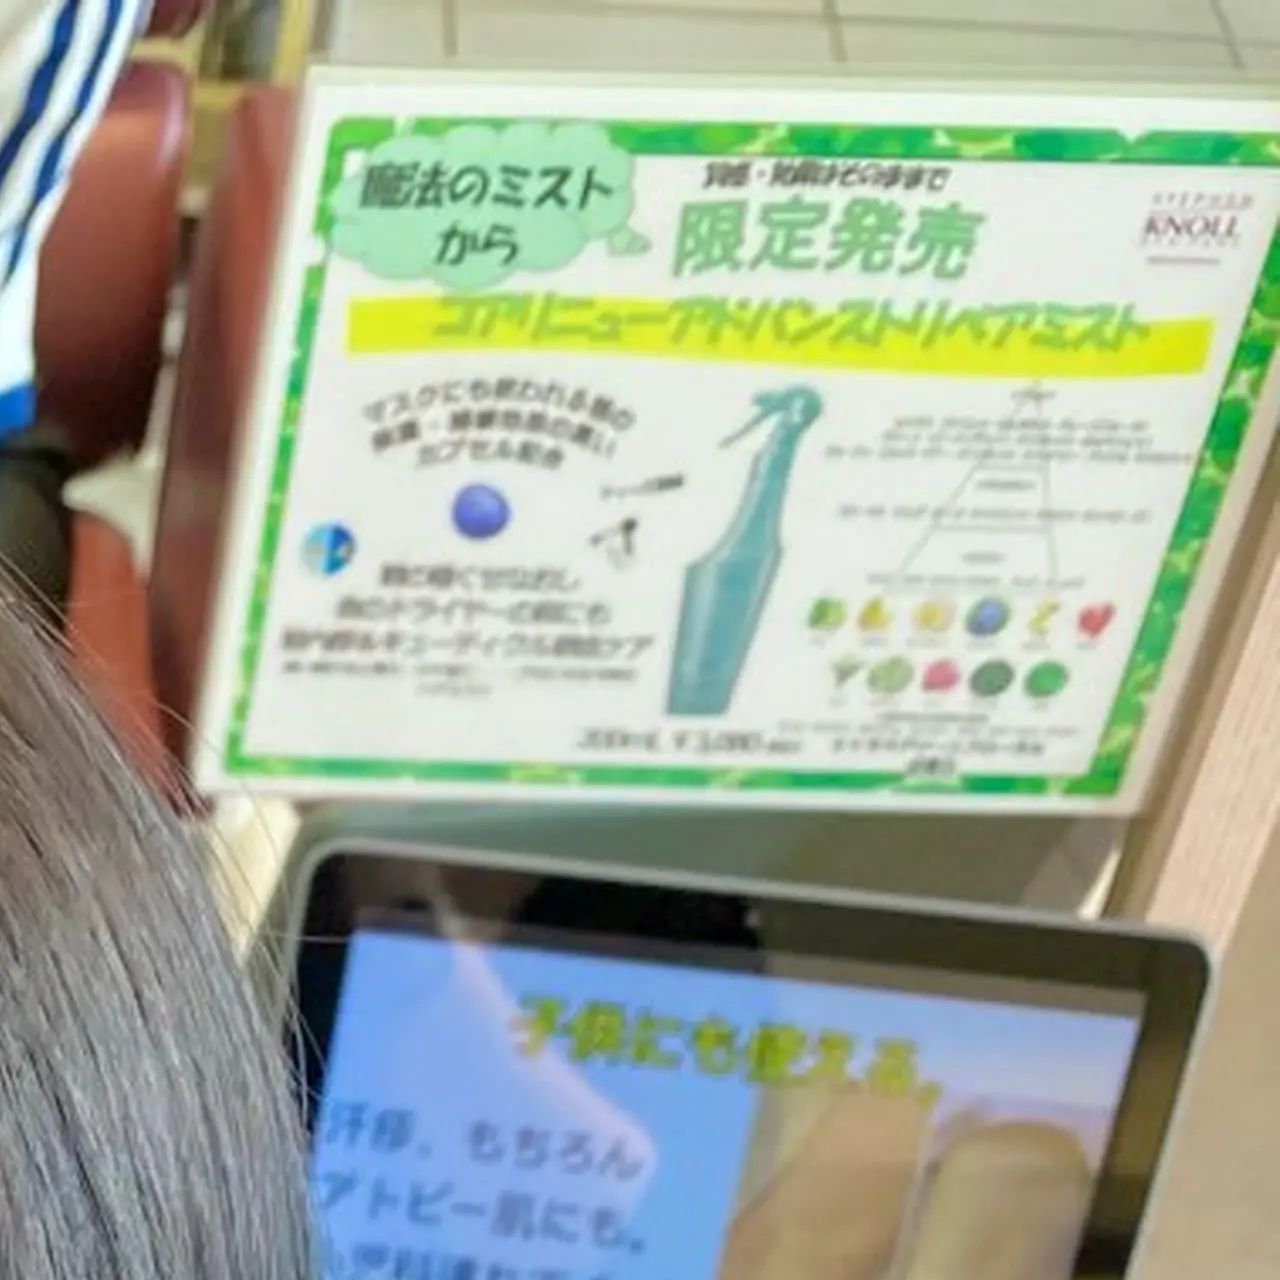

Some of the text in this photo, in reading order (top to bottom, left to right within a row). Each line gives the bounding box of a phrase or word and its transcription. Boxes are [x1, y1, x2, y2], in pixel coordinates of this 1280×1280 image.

[359, 160, 614, 210] 魔法のミスト
[435, 219, 519, 266] から
[672, 196, 987, 281] 限定発売
[1143, 214, 1240, 240] KNOLL
